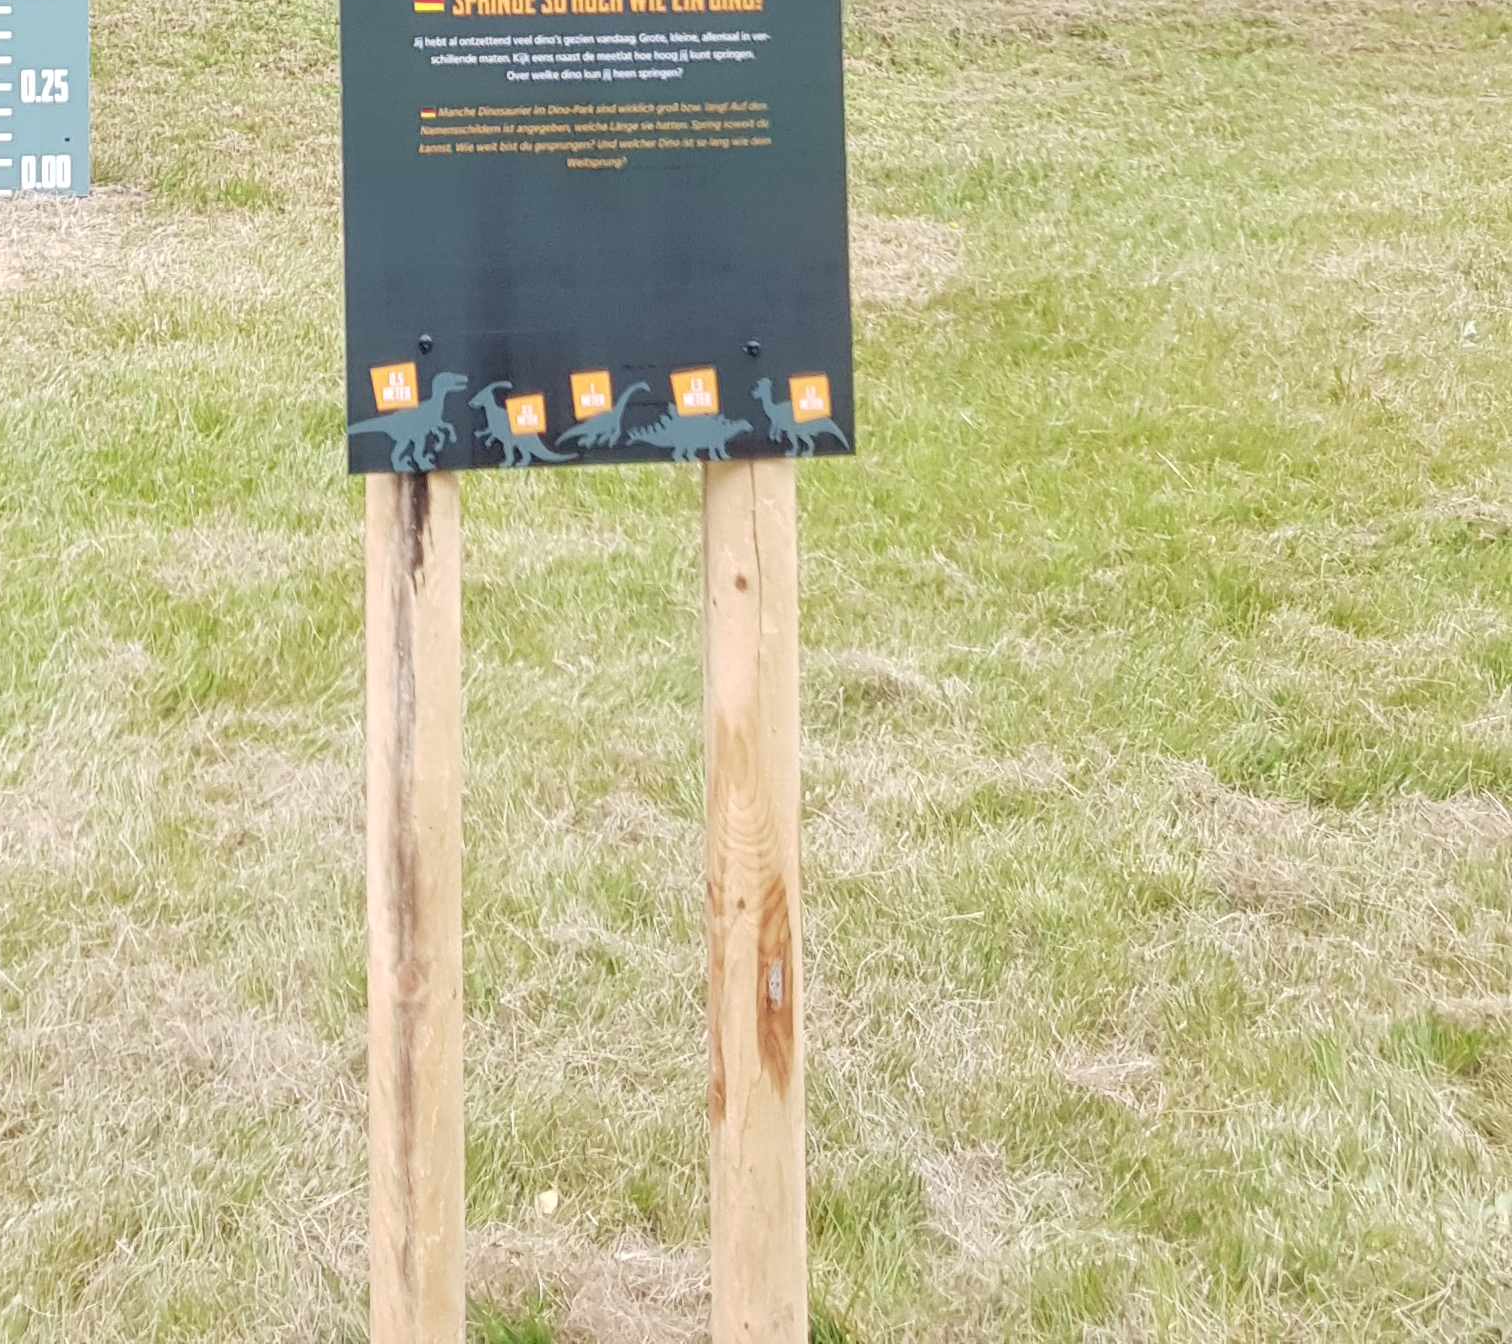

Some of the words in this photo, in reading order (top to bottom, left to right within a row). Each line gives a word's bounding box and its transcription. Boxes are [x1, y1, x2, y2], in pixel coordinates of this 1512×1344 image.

[413, 36, 423, 49] Jij
[425, 37, 447, 47] hebt
[449, 36, 457, 46] al
[459, 35, 511, 46] ontzettend
[513, 35, 532, 45] veel
[564, 34, 594, 46] gezien
[701, 32, 739, 41] allemaal
[741, 31, 750, 41] in
[431, 54, 477, 64] schillende
[512, 52, 529, 65] Kijk
[532, 54, 553, 63] eens
[555, 53, 580, 62] naast
[583, 52, 595, 61] de
[596, 51, 632, 61] meetlat
[634, 50, 652, 60] hoe
[654, 50, 678, 62] hoog
[679, 49, 688, 62] jij
[689, 49, 711, 59] kunt
[507, 70, 529, 80] Over
[532, 69, 559, 79] welke
[561, 69, 581, 79] dino
[583, 68, 601, 78] kun
[602, 68, 612, 81] jij
[613, 67, 637, 78] heen
[638, 67, 684, 81] springen?
[20, 69, 69, 103] 0.25
[21, 154, 71, 188] 0.00
[382, 387, 410, 401] METER
